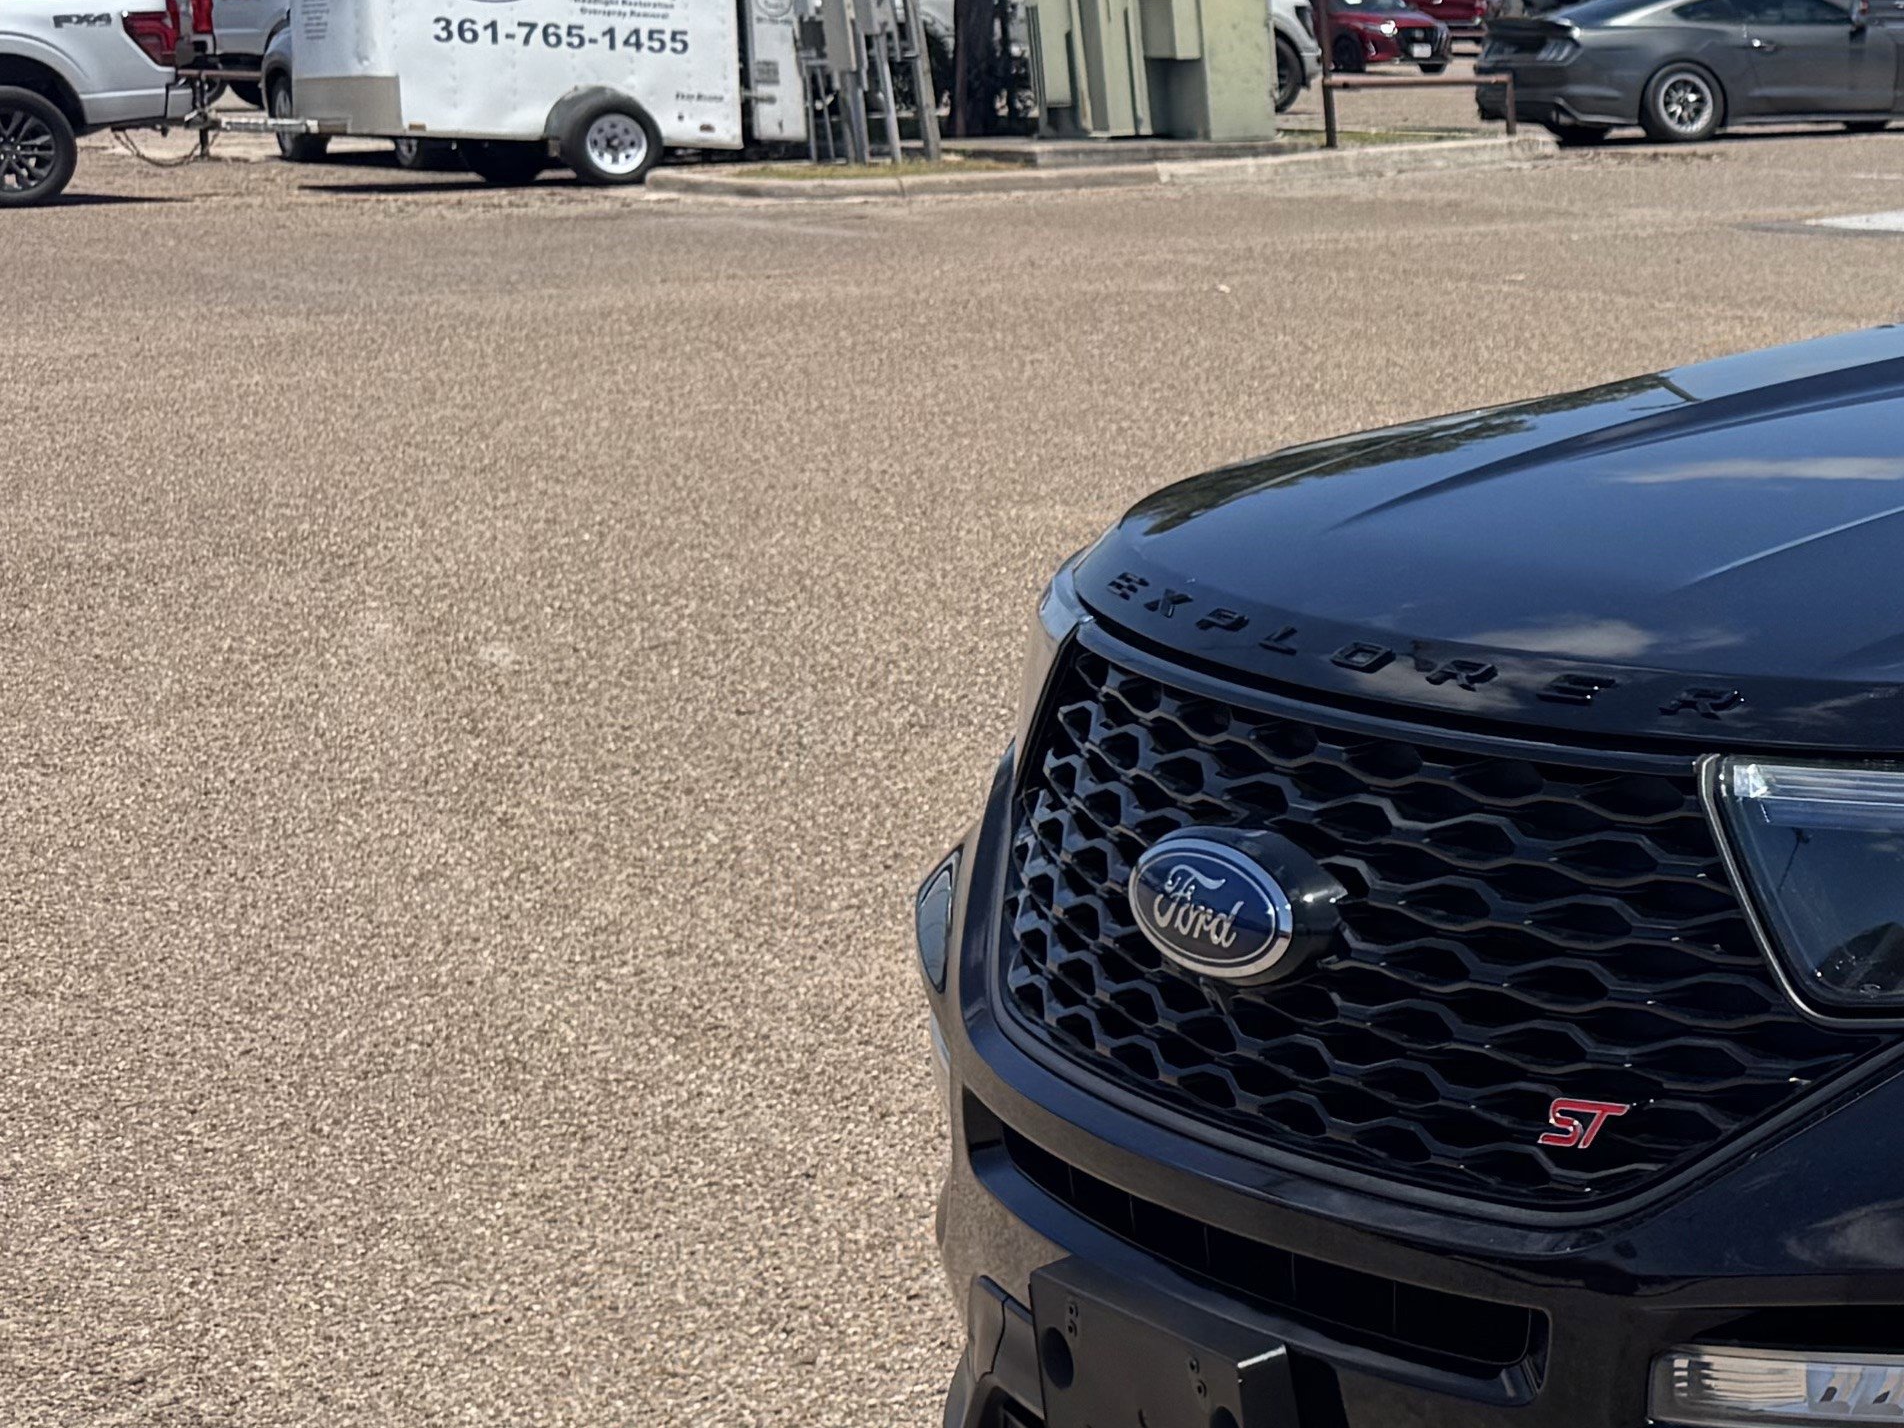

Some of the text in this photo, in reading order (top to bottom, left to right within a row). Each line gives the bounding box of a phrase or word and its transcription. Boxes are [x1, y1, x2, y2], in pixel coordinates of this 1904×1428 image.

[433, 17, 689, 55] 361-765-1455
[1106, 572, 1746, 721] EXPLORER
[1153, 864, 1245, 948] Ford
[1537, 1097, 1630, 1149] ST
